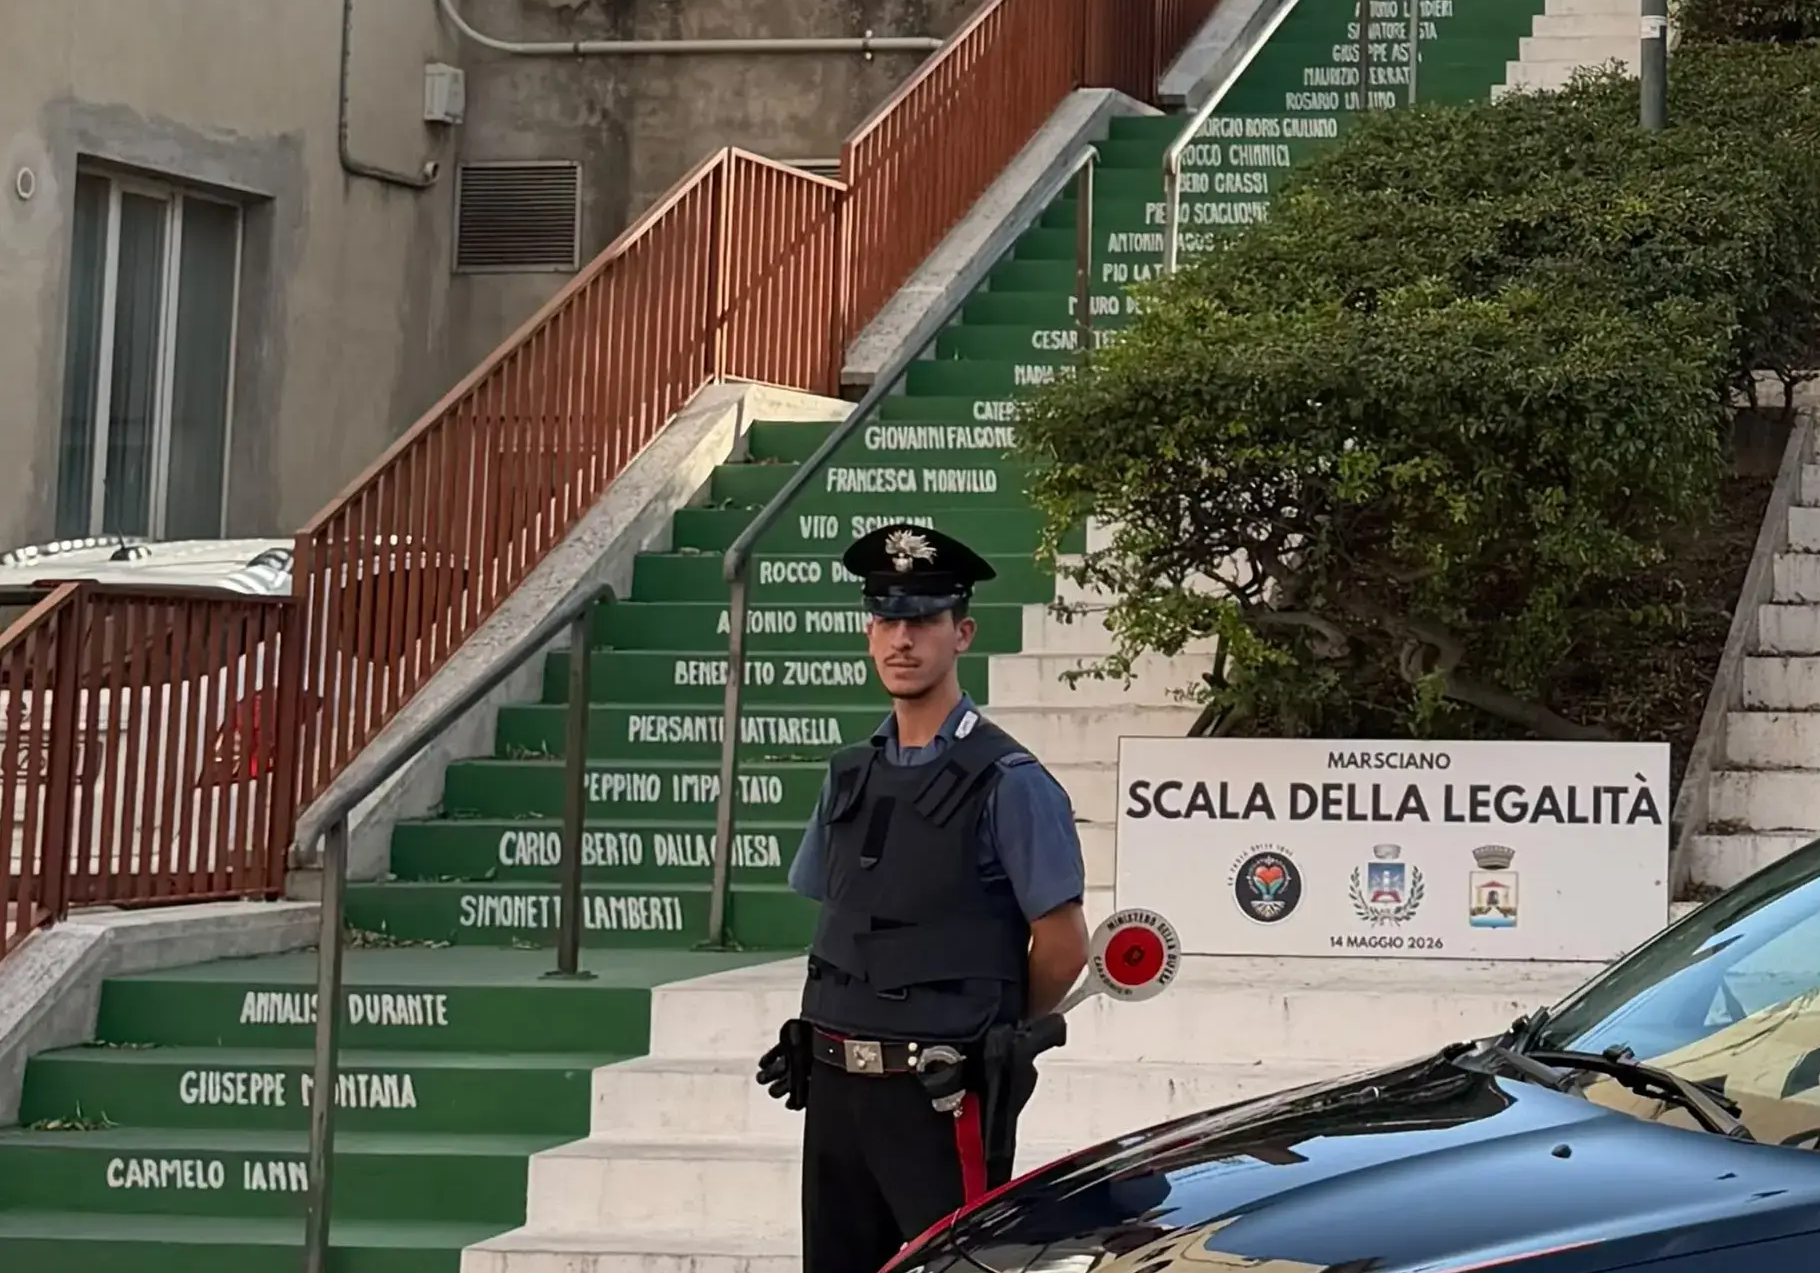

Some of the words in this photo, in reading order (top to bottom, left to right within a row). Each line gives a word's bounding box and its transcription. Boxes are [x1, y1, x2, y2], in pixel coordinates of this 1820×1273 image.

[1285, 92, 1339, 110] ROSARIO
[1246, 118, 1280, 138] BORIS
[1214, 172, 1269, 194] GRASSI
[1103, 263, 1128, 283] PIO
[865, 426, 945, 451] GIOVANNI
[948, 426, 1018, 450] FALCONE
[826, 468, 917, 494] FRANCESCA
[923, 469, 997, 494] MORVILLO
[800, 515, 839, 539] VITO
[760, 561, 822, 584] ROCCO
[782, 658, 867, 687] ZUCCARO
[628, 715, 724, 743] PIERSANTI
[741, 716, 842, 745] ATTARELLA
[1327, 751, 1452, 770] MARSCIANO
[673, 774, 783, 804] IMPATATO
[1126, 780, 1276, 821] SCALA
[1289, 782, 1430, 822] DELLA
[1443, 772, 1662, 825] LEGALITÀ
[499, 831, 561, 867] CARLO
[583, 896, 684, 931] LAMBERTI
[1329, 935, 1343, 949] 14
[1346, 935, 1404, 950] MAGGIO
[1406, 936, 1444, 950] 2026
[239, 991, 320, 1024] ANNALIS
[349, 994, 448, 1026] DURANTE
[179, 1071, 287, 1107] GIUSEPPE
[107, 1158, 224, 1190] CARMELO
